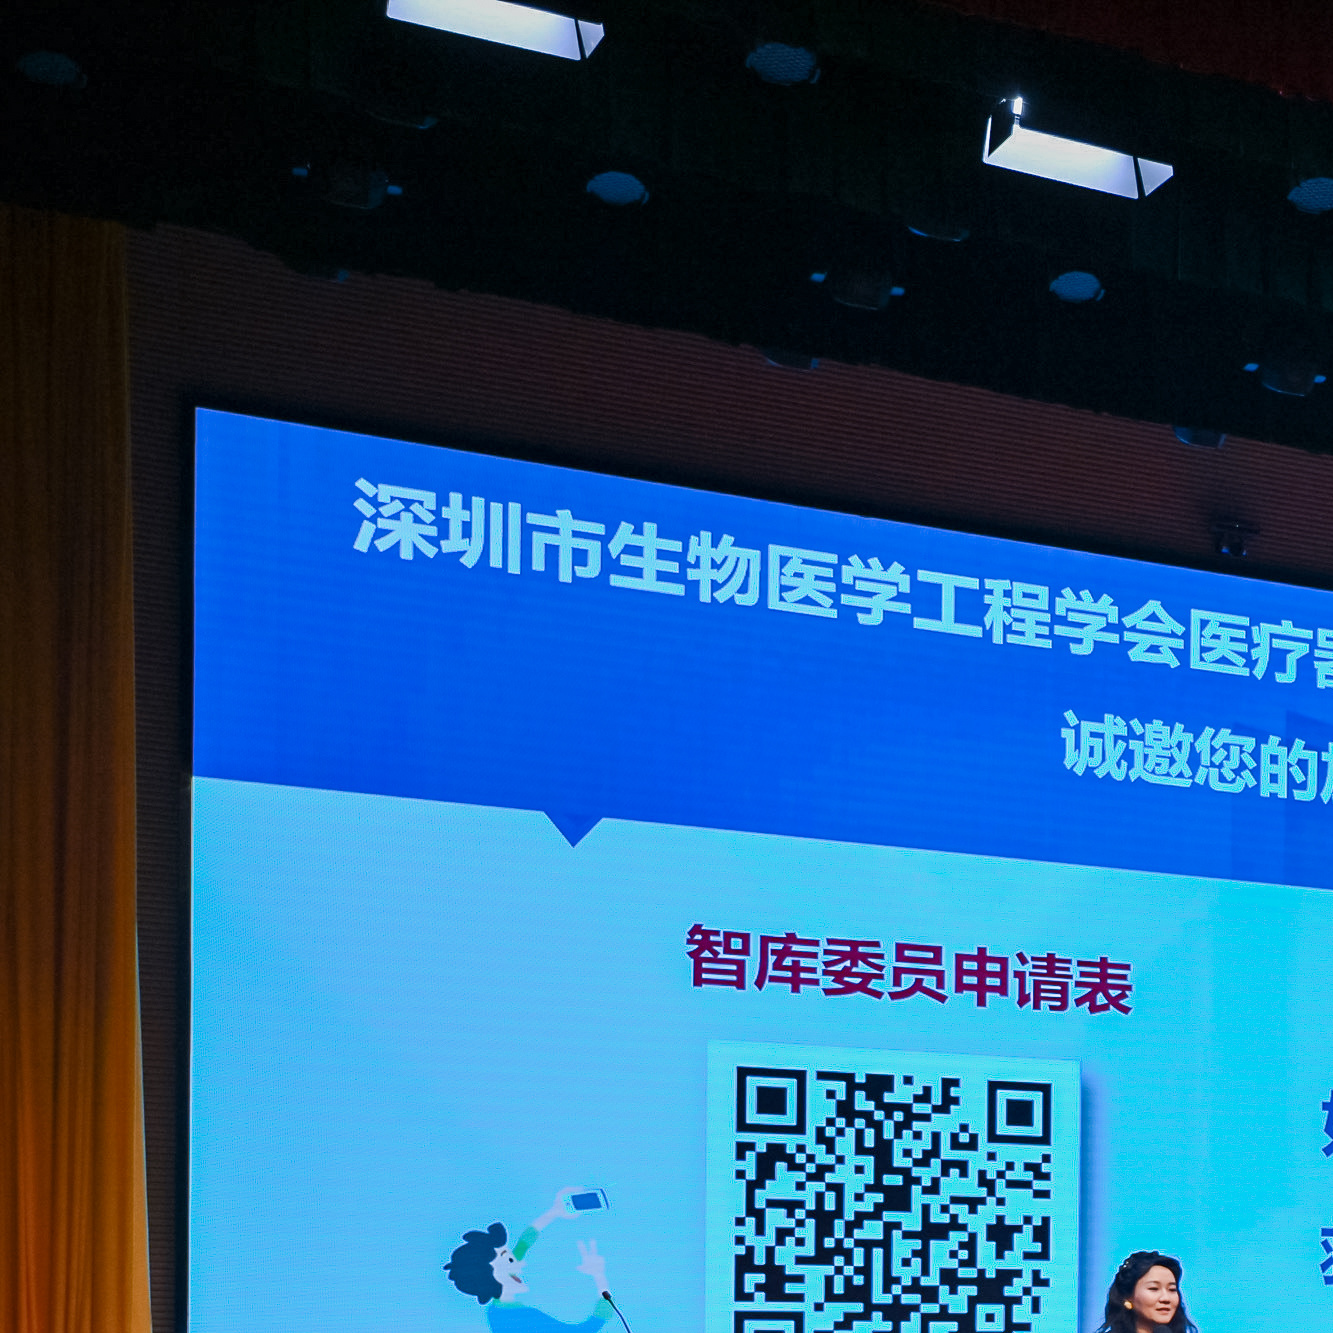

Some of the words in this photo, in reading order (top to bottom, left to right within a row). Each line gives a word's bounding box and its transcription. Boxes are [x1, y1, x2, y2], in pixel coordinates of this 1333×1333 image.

[685, 923, 1134, 1016] 智库委员申请表
